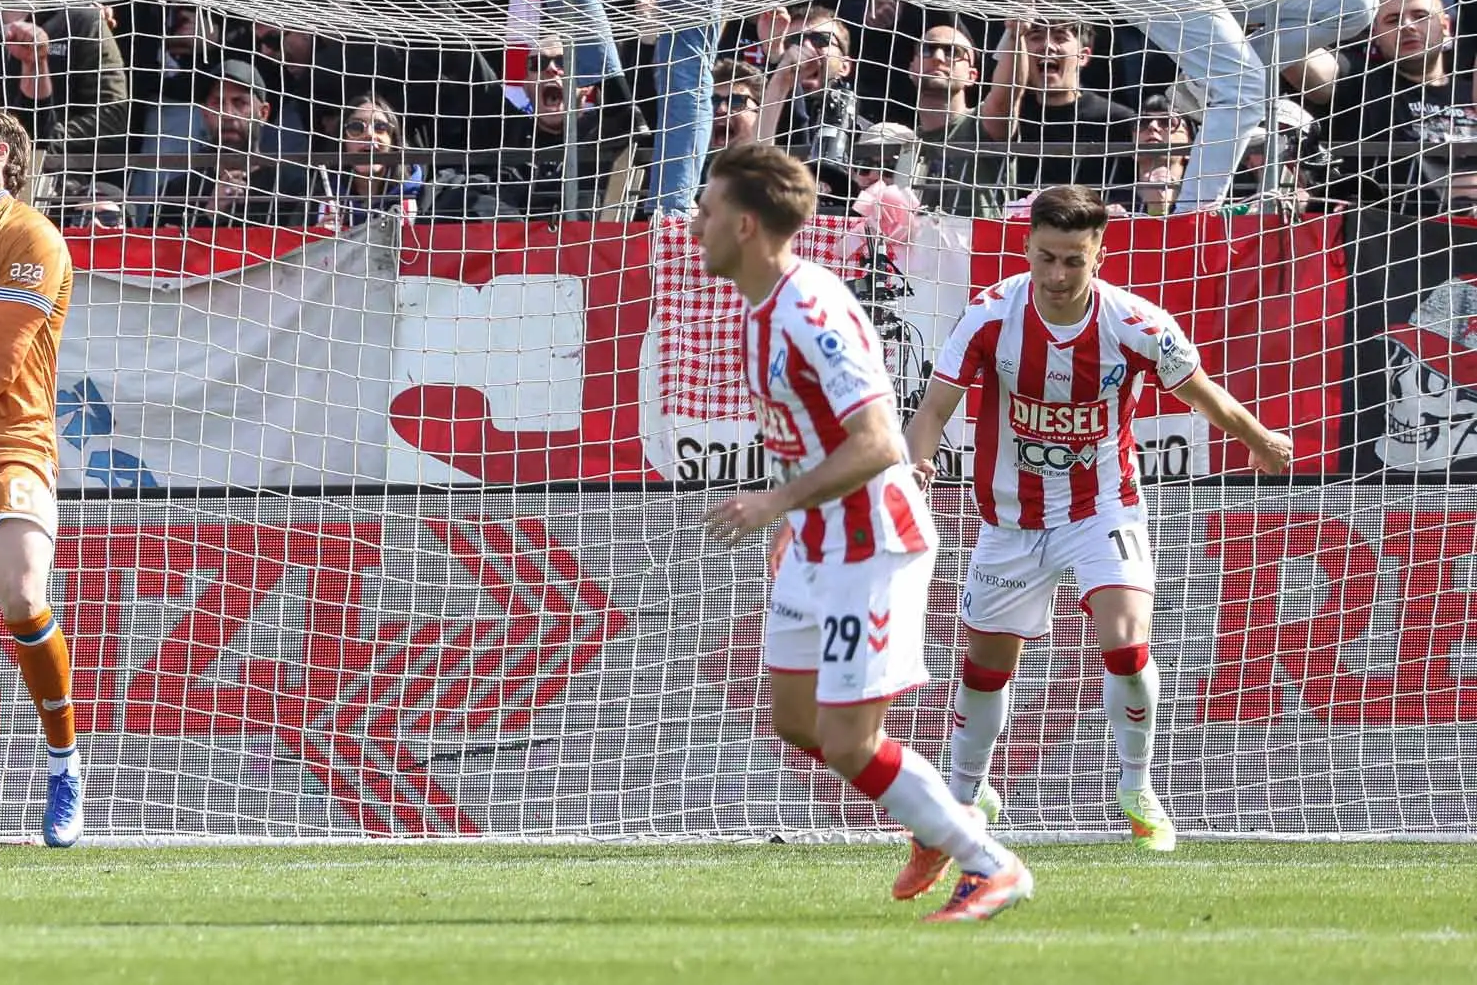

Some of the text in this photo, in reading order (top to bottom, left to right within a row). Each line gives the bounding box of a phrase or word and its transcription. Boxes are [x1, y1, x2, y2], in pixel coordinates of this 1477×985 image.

[10, 262, 45, 280] a2a
[1013, 397, 1105, 435] DIESEL
[1107, 529, 1145, 562] 11
[824, 615, 861, 663] 29
